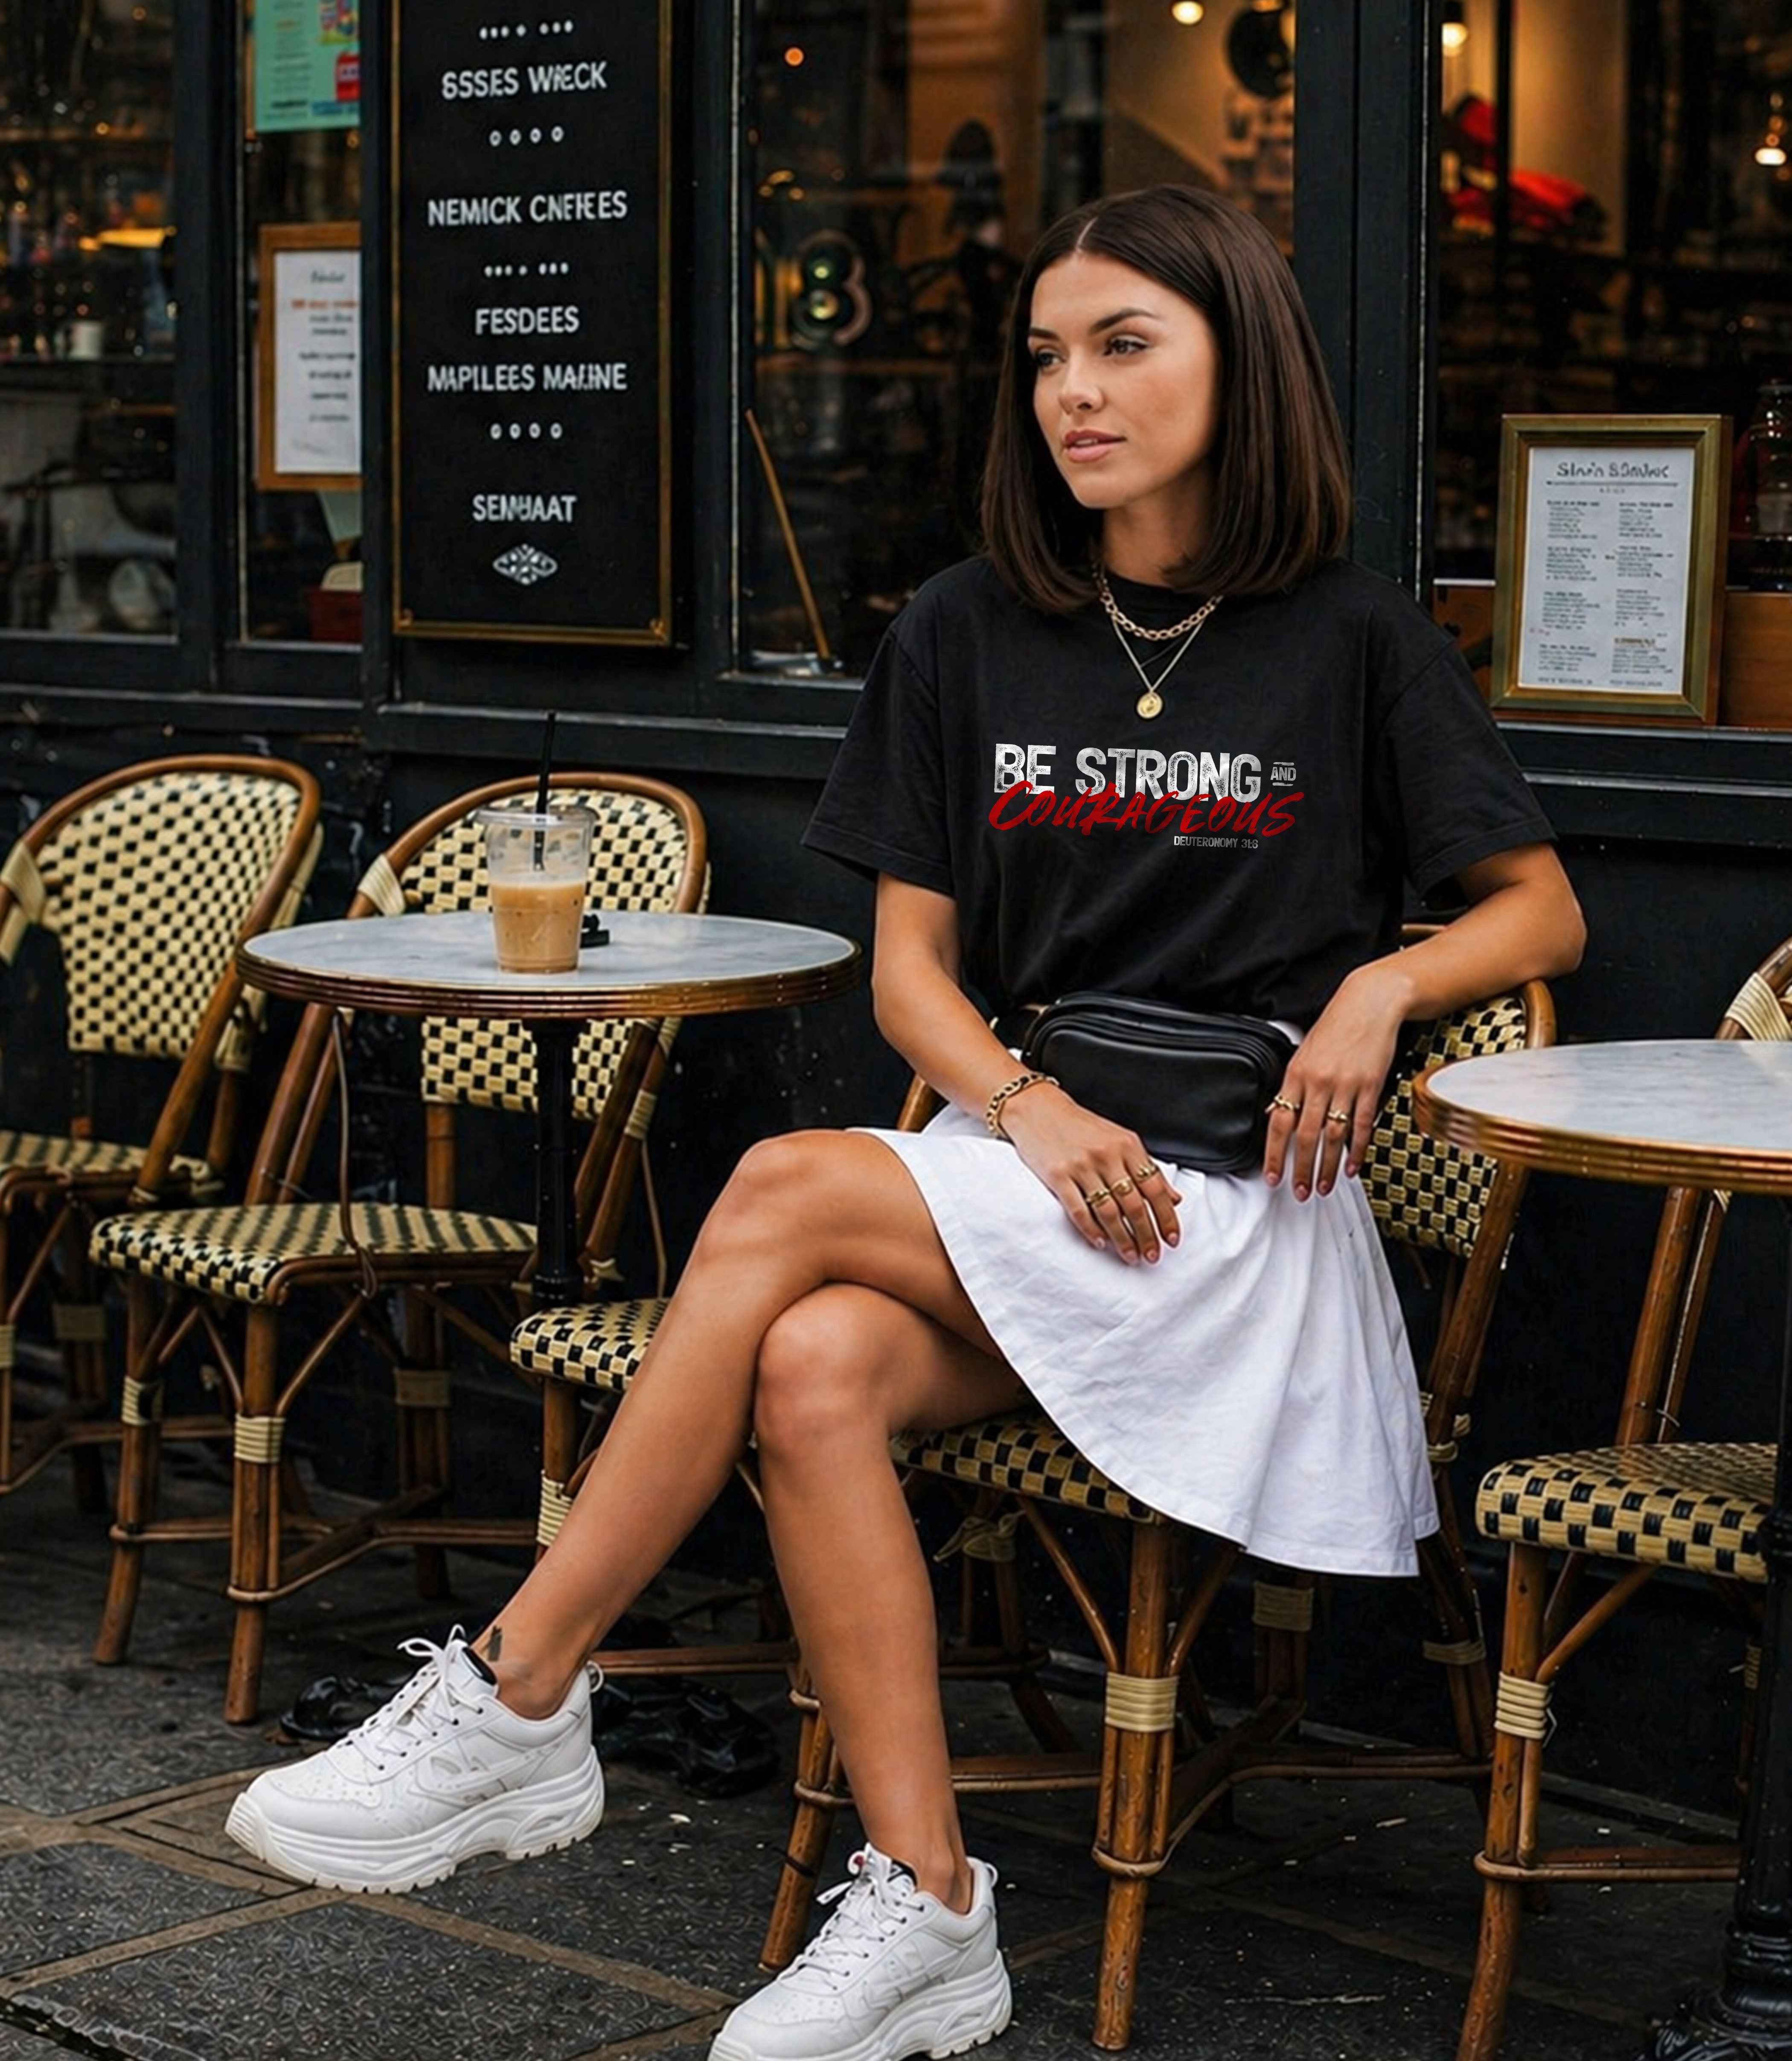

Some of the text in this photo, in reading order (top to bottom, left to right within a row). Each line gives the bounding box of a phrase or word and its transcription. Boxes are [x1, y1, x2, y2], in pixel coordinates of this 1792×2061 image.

[475, 305, 580, 335] FESDEES
[993, 743, 1297, 803] BE STRONG AND
[988, 780, 1305, 838] COURAGEOUS
[1174, 835, 1259, 849] DEUTERONOMY 31:6
